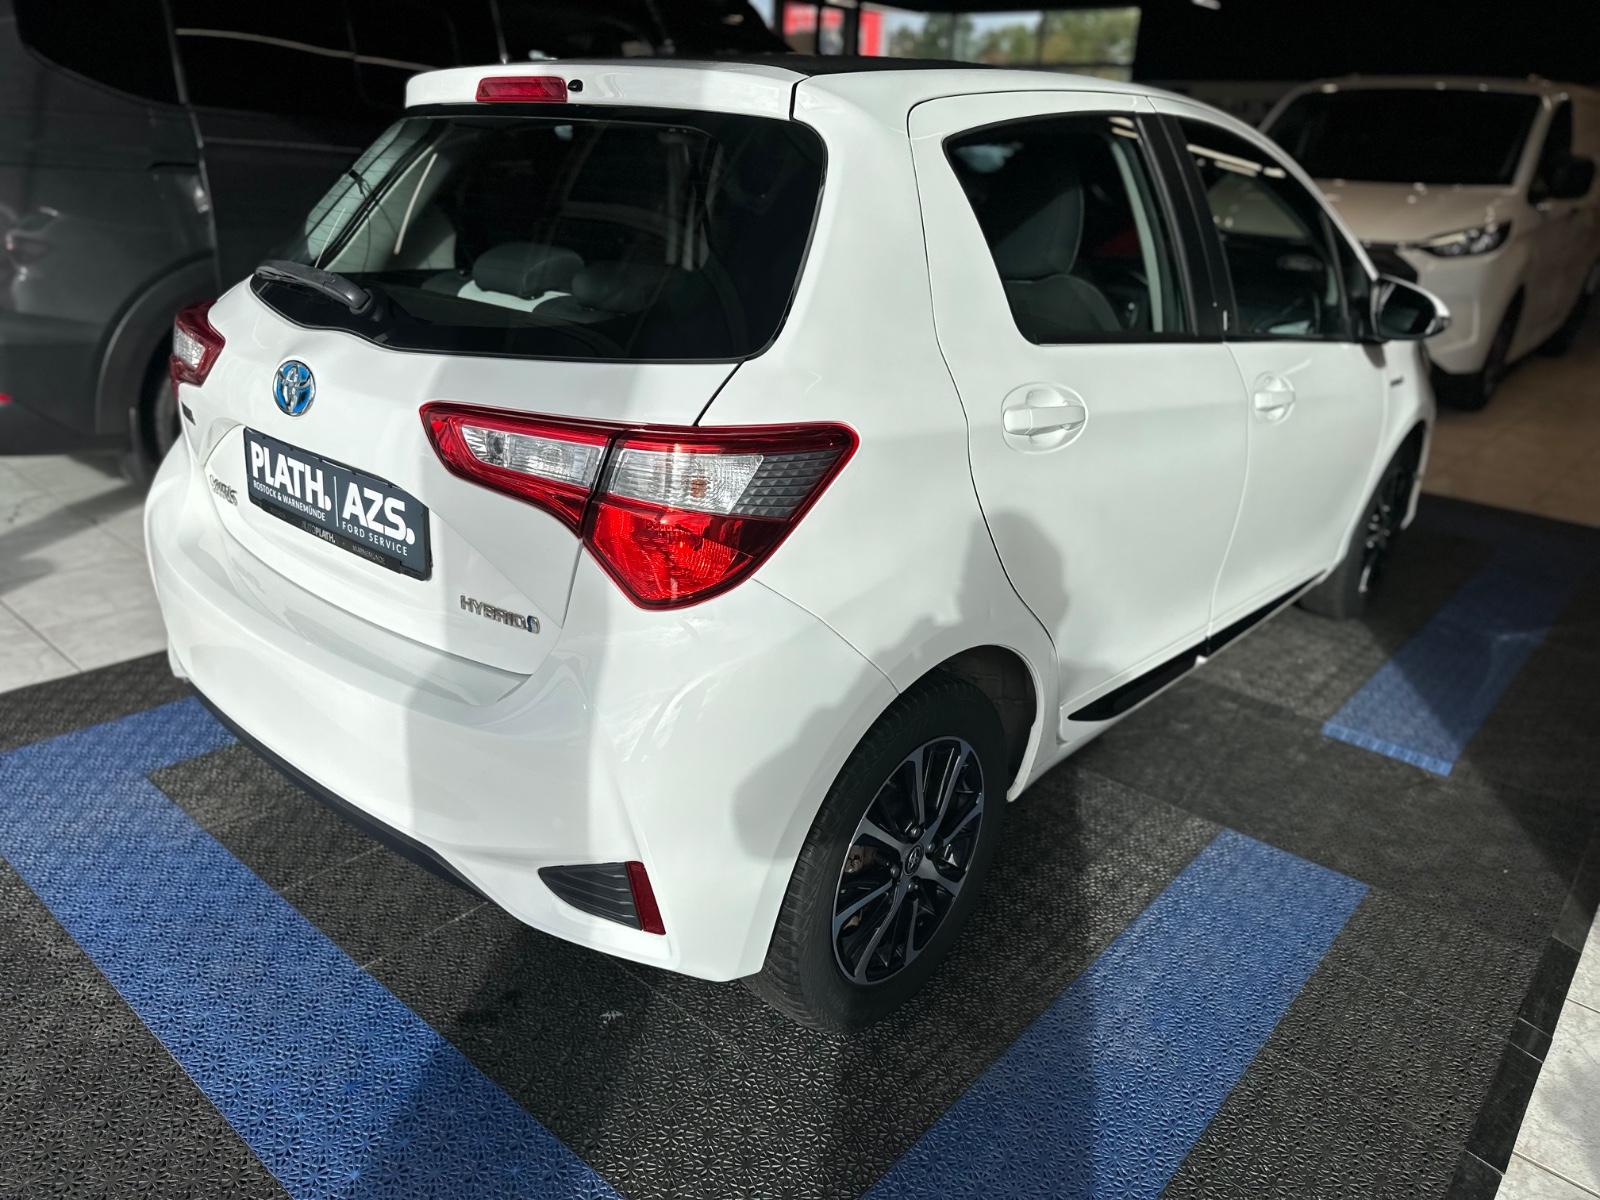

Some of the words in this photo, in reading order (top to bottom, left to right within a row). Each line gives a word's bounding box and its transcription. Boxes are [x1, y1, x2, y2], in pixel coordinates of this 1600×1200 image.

[250, 440, 332, 511] PLATH.
[253, 480, 277, 499] ROSTOCK
[277, 492, 282, 502] &
[282, 494, 326, 522] WARNEMÜNDE
[342, 481, 415, 545] AZS.
[342, 521, 365, 538] FORD
[368, 532, 408, 557] SERVICE
